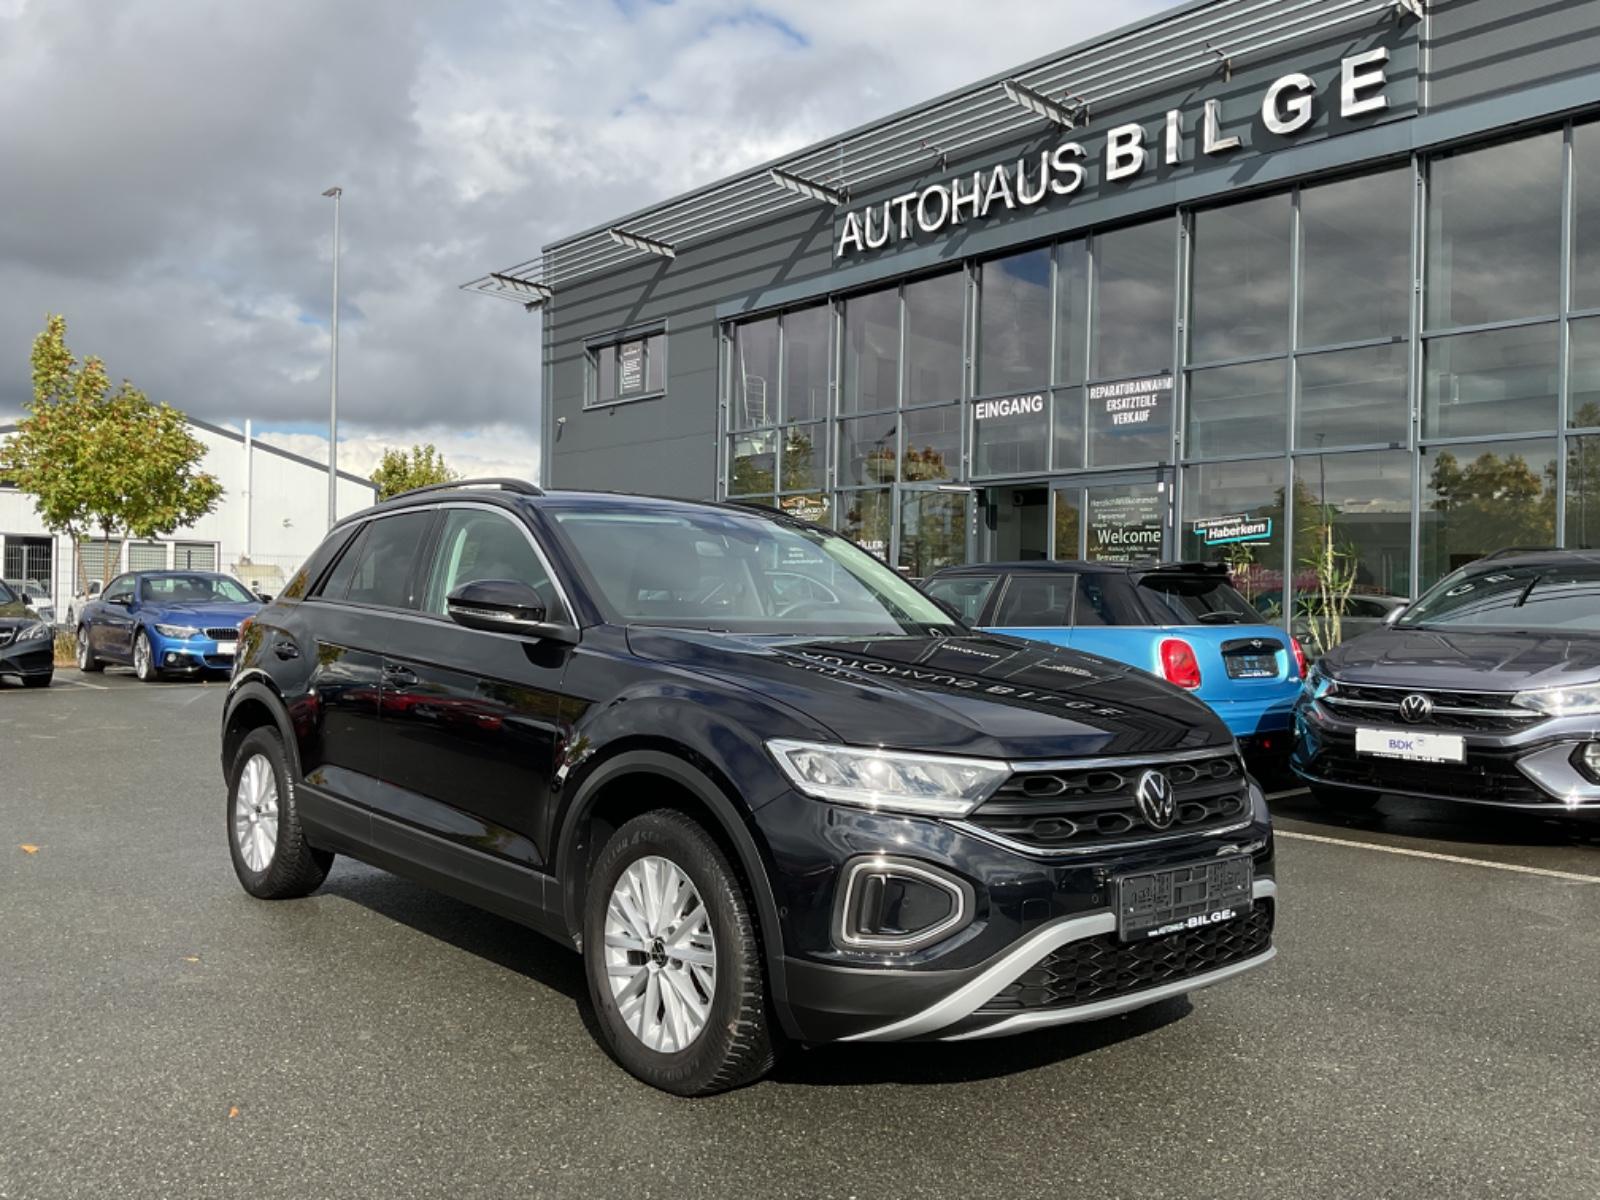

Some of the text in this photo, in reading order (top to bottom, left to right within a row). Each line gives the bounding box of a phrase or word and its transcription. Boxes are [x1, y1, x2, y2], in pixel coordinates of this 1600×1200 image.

[836, 47, 1391, 258] AUTOHAUS BILGE
[975, 395, 1044, 419] EINGANG
[1106, 394, 1158, 412] ERSATZTEILE
[1112, 409, 1151, 424] VERKAUF
[1097, 528, 1161, 544] Welcome
[1209, 523, 1266, 539] Haberkern
[1388, 739, 1414, 751] BDK
